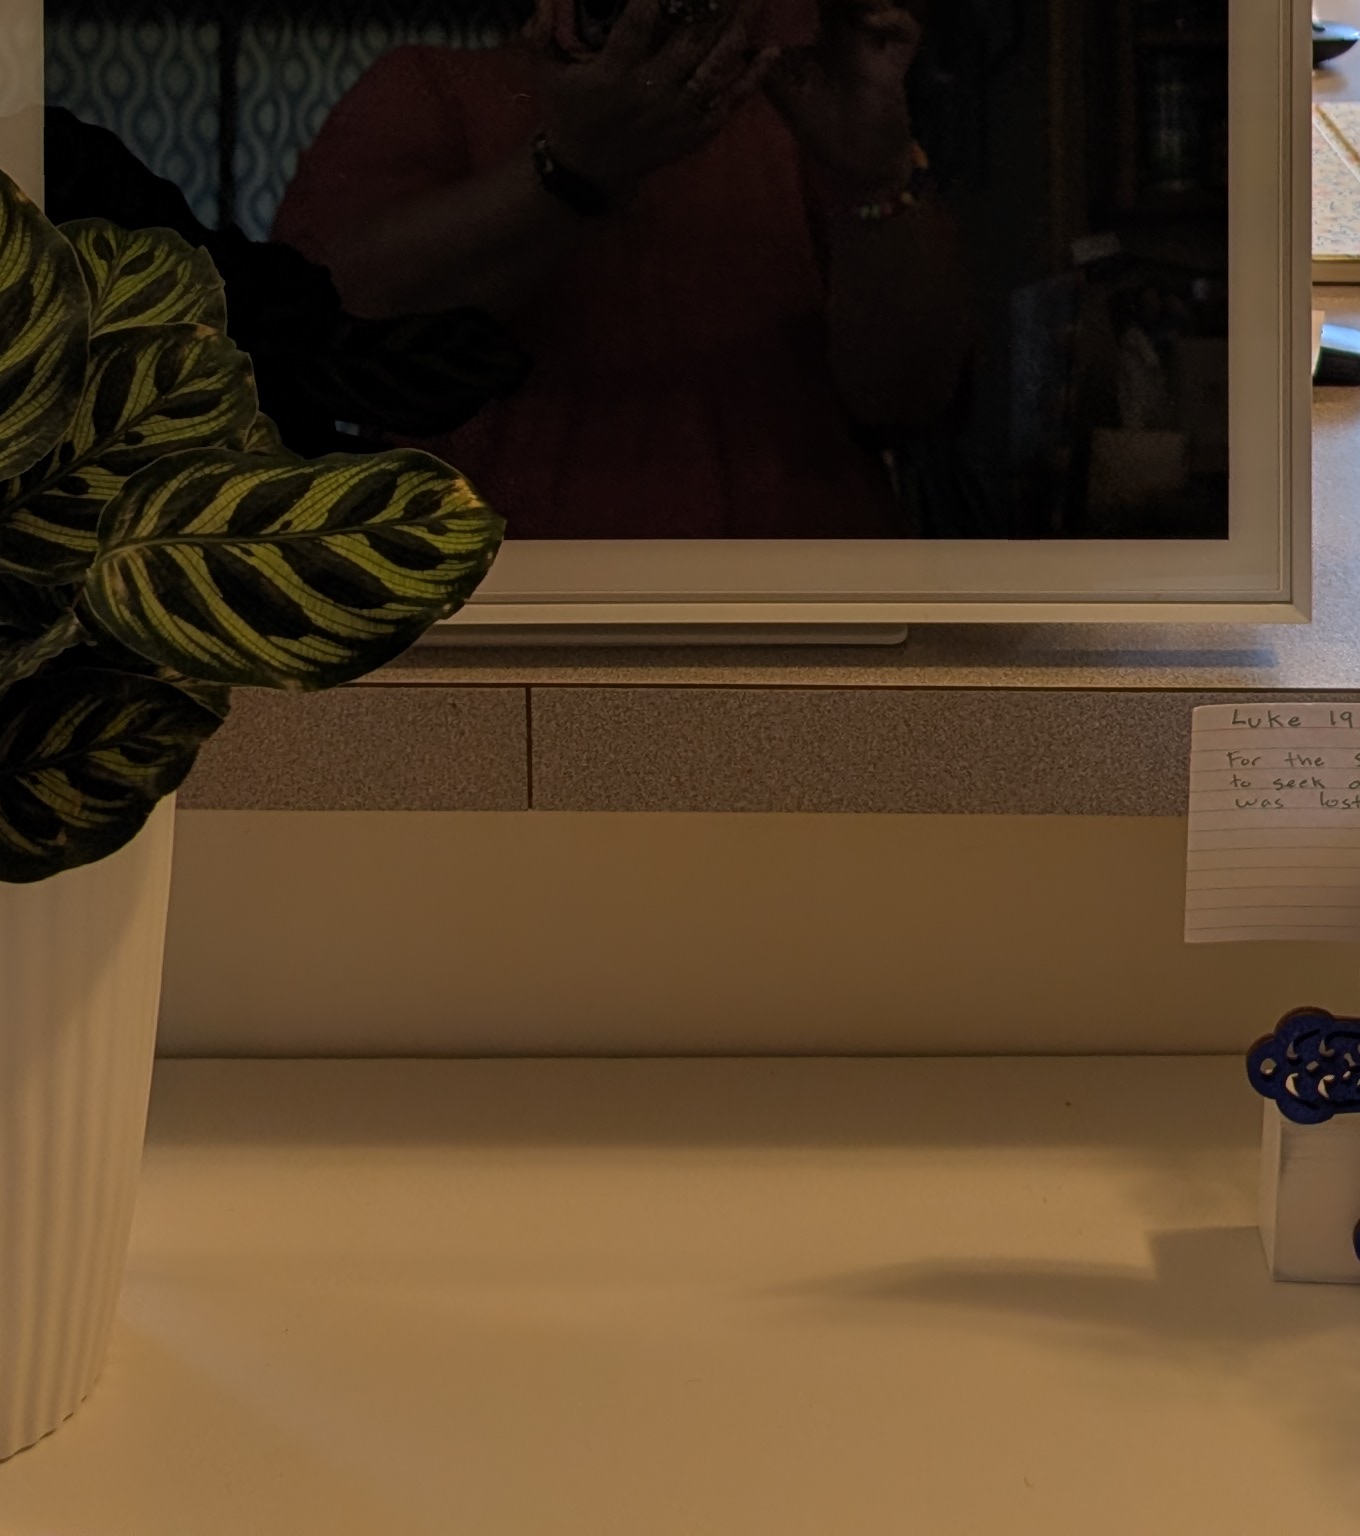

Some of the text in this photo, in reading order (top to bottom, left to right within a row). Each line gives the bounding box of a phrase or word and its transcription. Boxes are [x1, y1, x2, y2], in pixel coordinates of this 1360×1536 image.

[1231, 709, 1302, 729] Luke
[1226, 750, 1262, 769] For
[1283, 751, 1326, 767] the
[1229, 773, 1253, 789] to
[1272, 775, 1326, 791] seek
[1235, 797, 1285, 809] was
